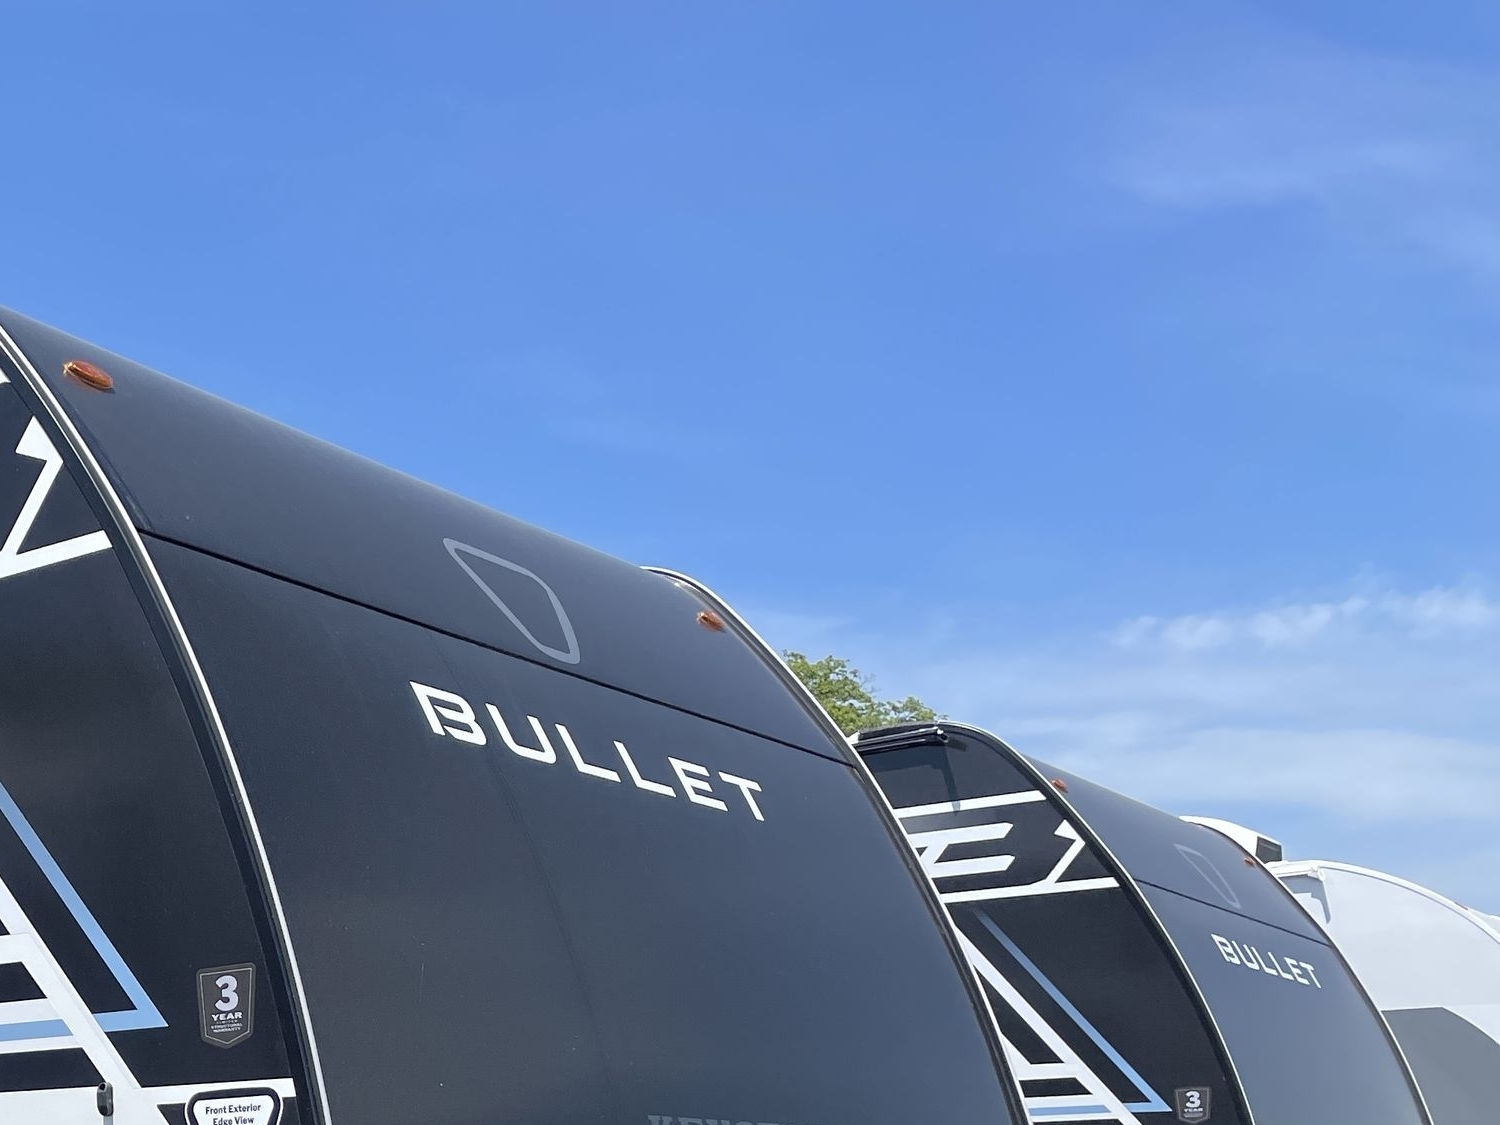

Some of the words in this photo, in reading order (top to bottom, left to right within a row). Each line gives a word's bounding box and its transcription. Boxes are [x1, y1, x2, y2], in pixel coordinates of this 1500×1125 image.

[409, 681, 765, 822] BULLET
[1210, 933, 1321, 989] BULLET
[215, 975, 239, 1011] 3
[211, 1012, 243, 1021] YEAR
[1185, 1091, 1201, 1108] 3
[205, 1106, 227, 1115] Front
[228, 1103, 262, 1113] Exterior
[234, 1116, 255, 1125] View
